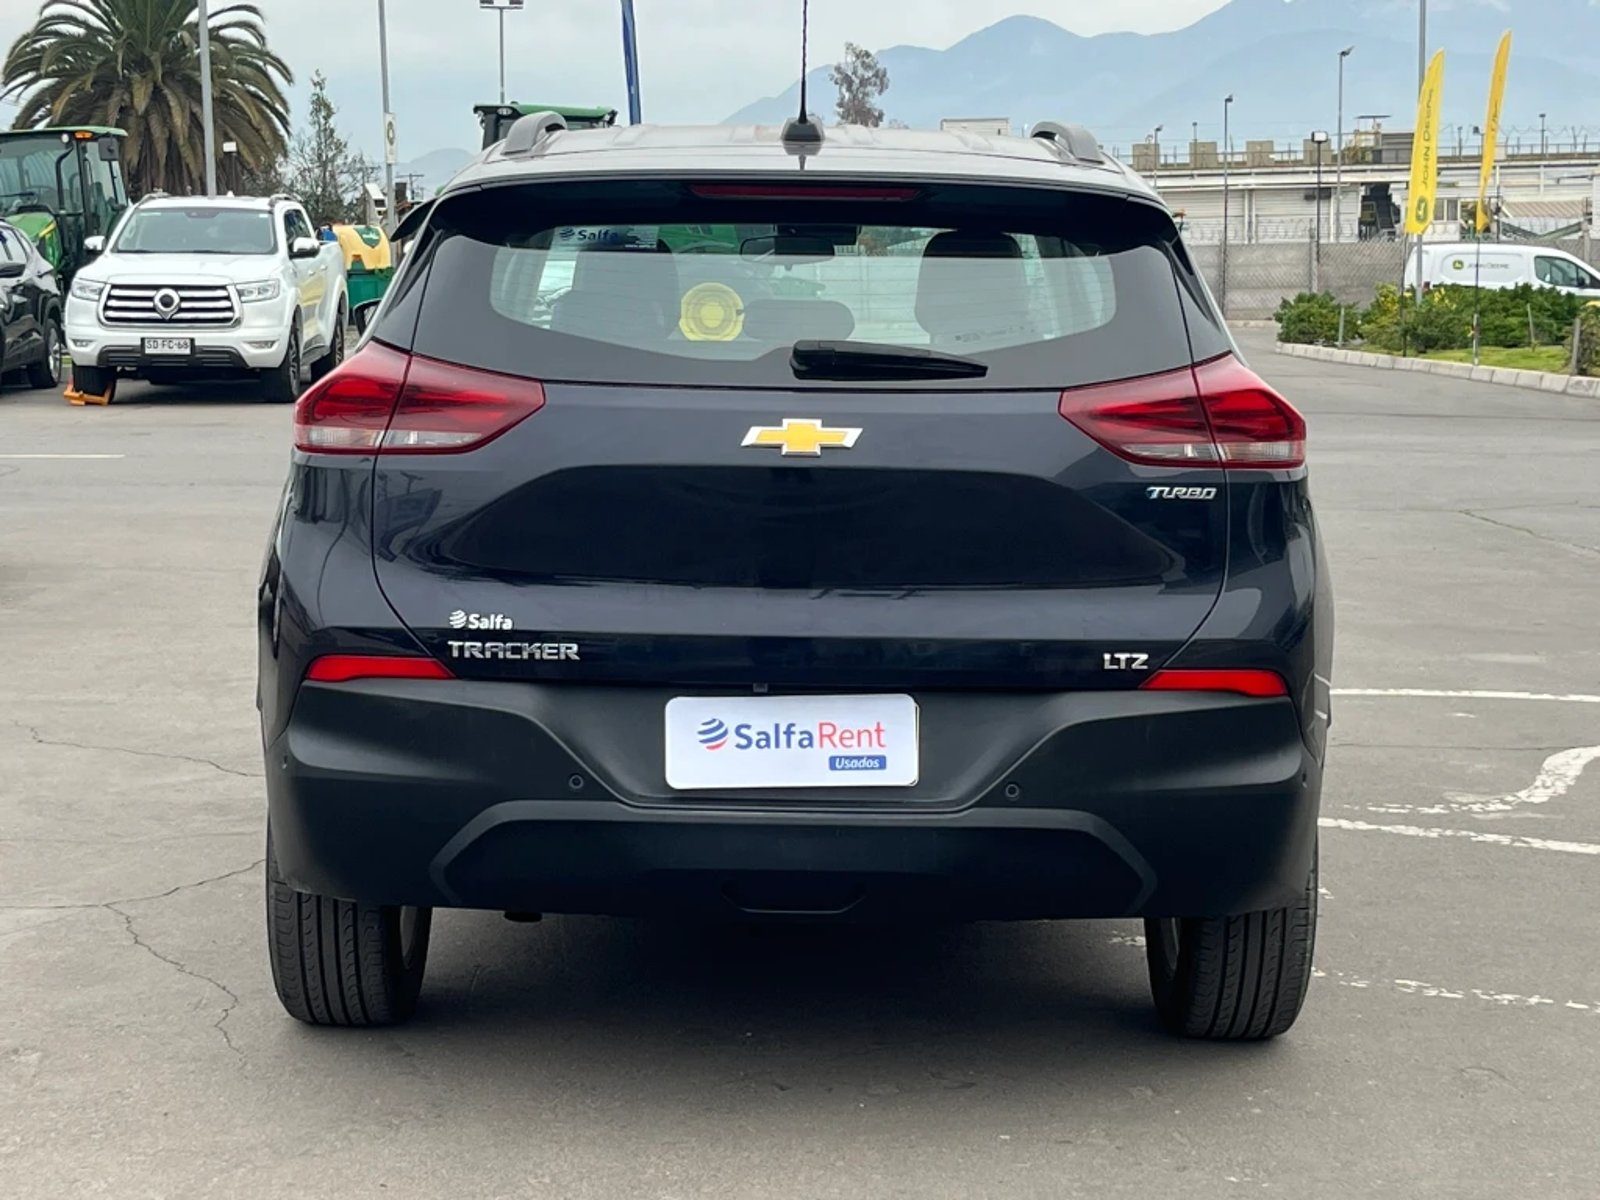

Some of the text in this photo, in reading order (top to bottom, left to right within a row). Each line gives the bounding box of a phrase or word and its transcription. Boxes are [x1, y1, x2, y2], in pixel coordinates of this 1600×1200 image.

[1146, 486, 1217, 500] TURBO
[468, 613, 513, 631] Salfa
[448, 640, 581, 661] TRACKER
[1103, 653, 1149, 670] LTZ
[834, 756, 881, 770] Usados
